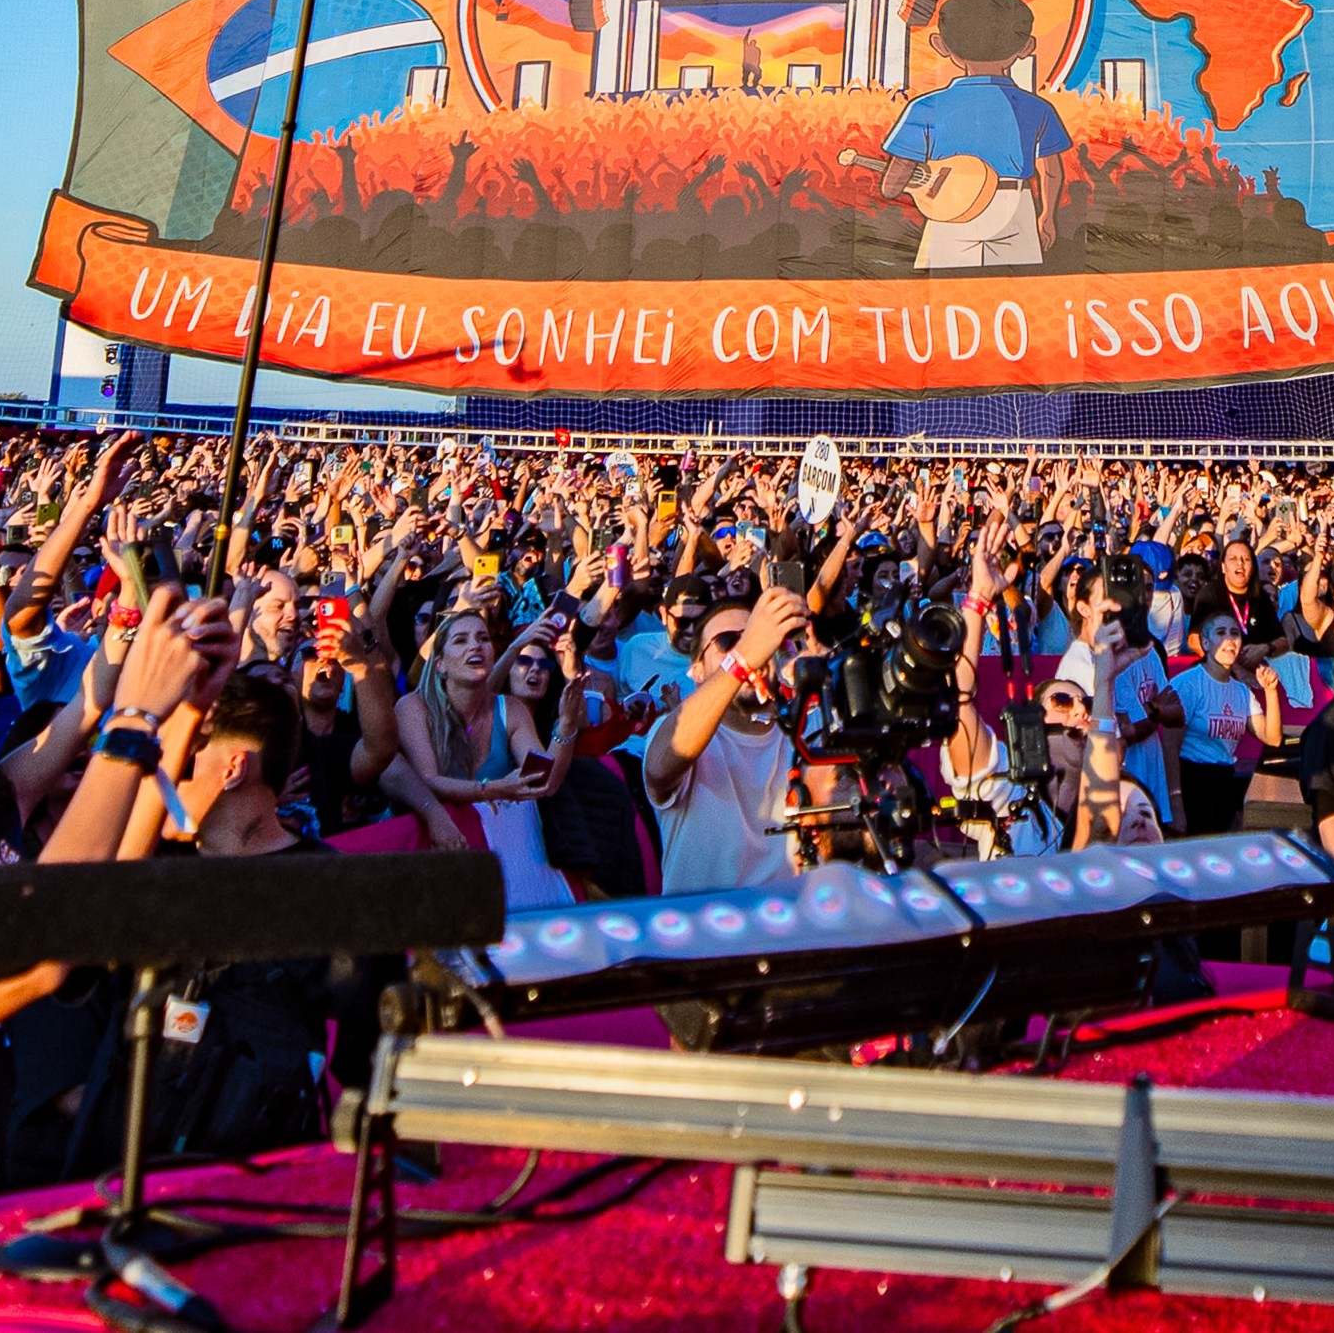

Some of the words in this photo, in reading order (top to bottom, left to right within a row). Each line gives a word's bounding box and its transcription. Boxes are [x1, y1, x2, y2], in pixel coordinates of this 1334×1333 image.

[130, 267, 213, 332] UM
[361, 302, 427, 359] EU
[712, 305, 831, 365] COM
[859, 300, 1029, 364] TUDO
[802, 463, 836, 493] GARÇOM
